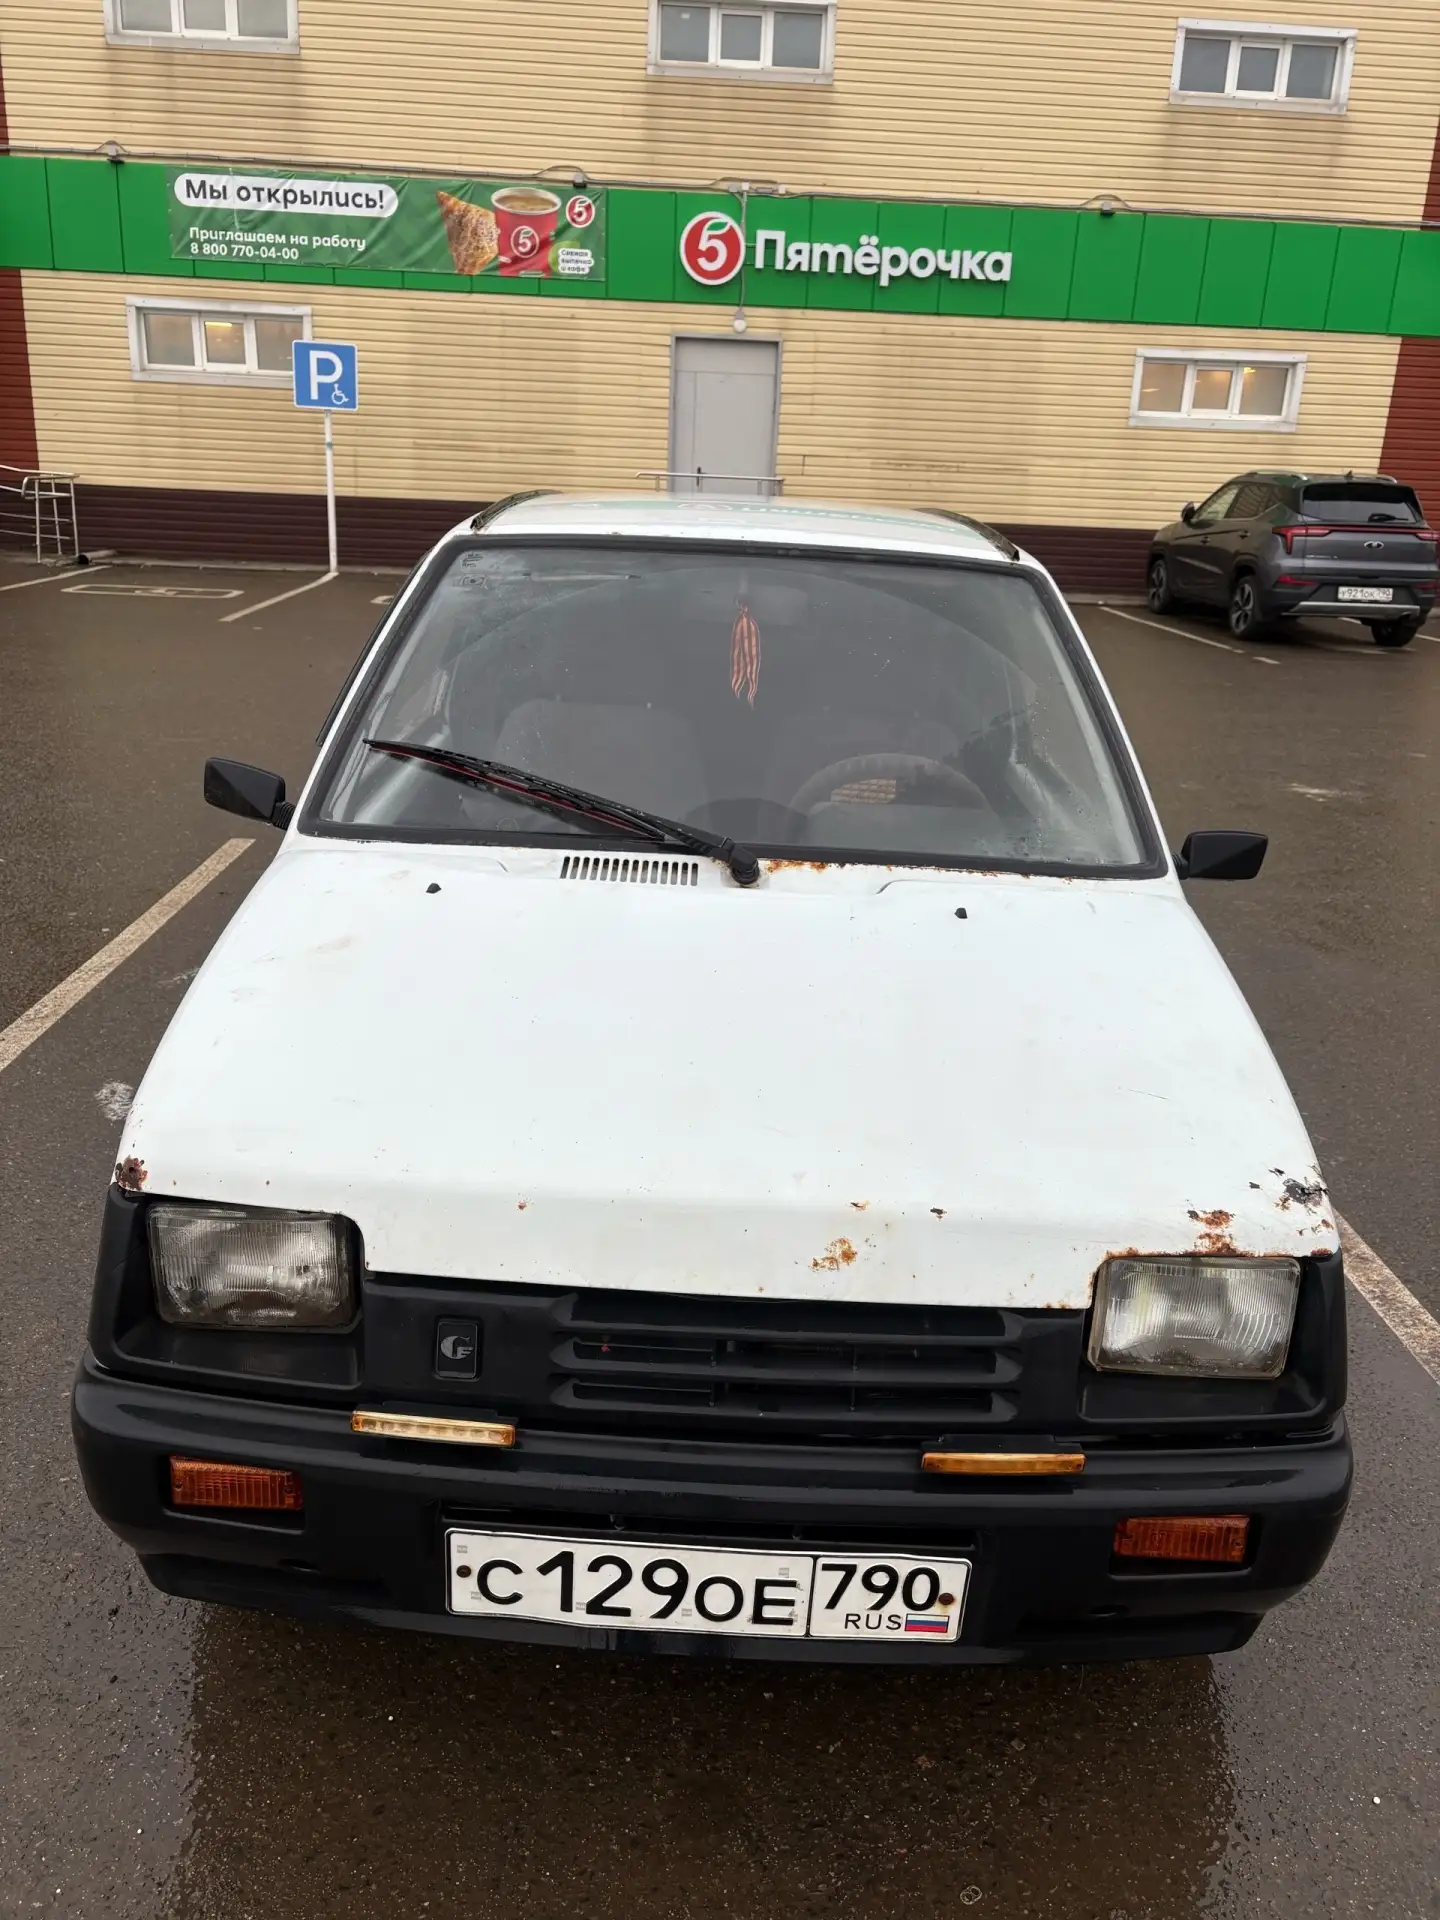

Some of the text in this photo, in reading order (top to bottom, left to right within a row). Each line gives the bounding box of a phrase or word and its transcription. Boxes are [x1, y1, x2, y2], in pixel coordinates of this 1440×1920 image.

[185, 178, 385, 210] Мы открылись!
[189, 227, 366, 251] Приглашаем на работу
[190, 242, 299, 260] 8 800 770-04-00
[697, 217, 731, 272] 5
[754, 229, 1013, 287] Пятёрочка
[309, 350, 343, 400] P
[821, 1563, 941, 1612] 790
[844, 1613, 902, 1631] RUS
